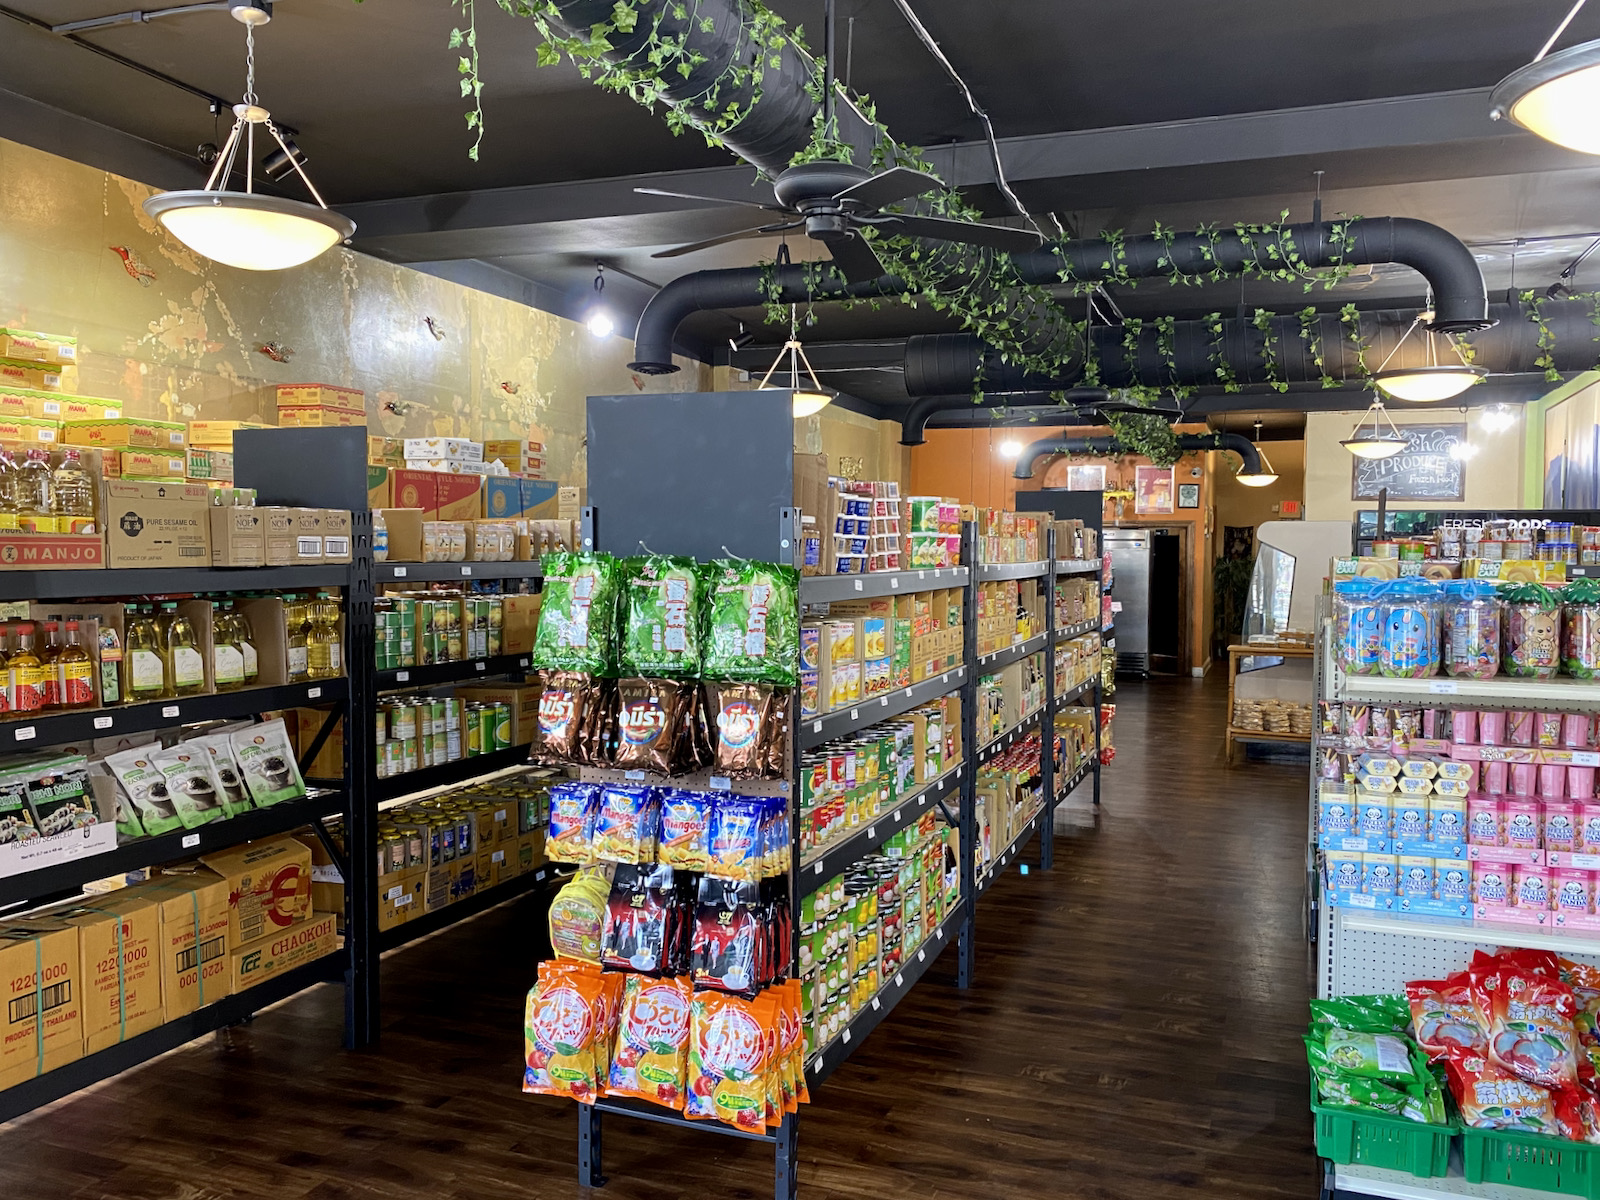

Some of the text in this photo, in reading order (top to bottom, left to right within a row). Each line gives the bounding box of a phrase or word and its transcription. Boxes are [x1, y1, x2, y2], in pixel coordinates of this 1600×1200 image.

[13, 340, 36, 349] MAMA
[2, 368, 24, 378] MAMA
[2, 397, 24, 406] MAMA
[68, 405, 87, 413] MAMA
[134, 428, 152, 436] MAMA
[134, 456, 152, 464] MAMA
[24, 548, 96, 560] MANJO
[1478, 569, 1499, 578] CAKE
[54, 780, 83, 794] NORI
[552, 812, 588, 827] Mangoes
[602, 806, 639, 823] Mangoes
[664, 816, 706, 832] Mangoes
[10, 836, 41, 850] ROASTED
[1520, 887, 1546, 895] HELLO
[271, 920, 332, 956] CHAOKOH
[128, 971, 145, 981] WATER
[180, 960, 224, 988] 1220000
[46, 1010, 77, 1028] THAILAND
[5, 1026, 35, 1044] PRODUCT
